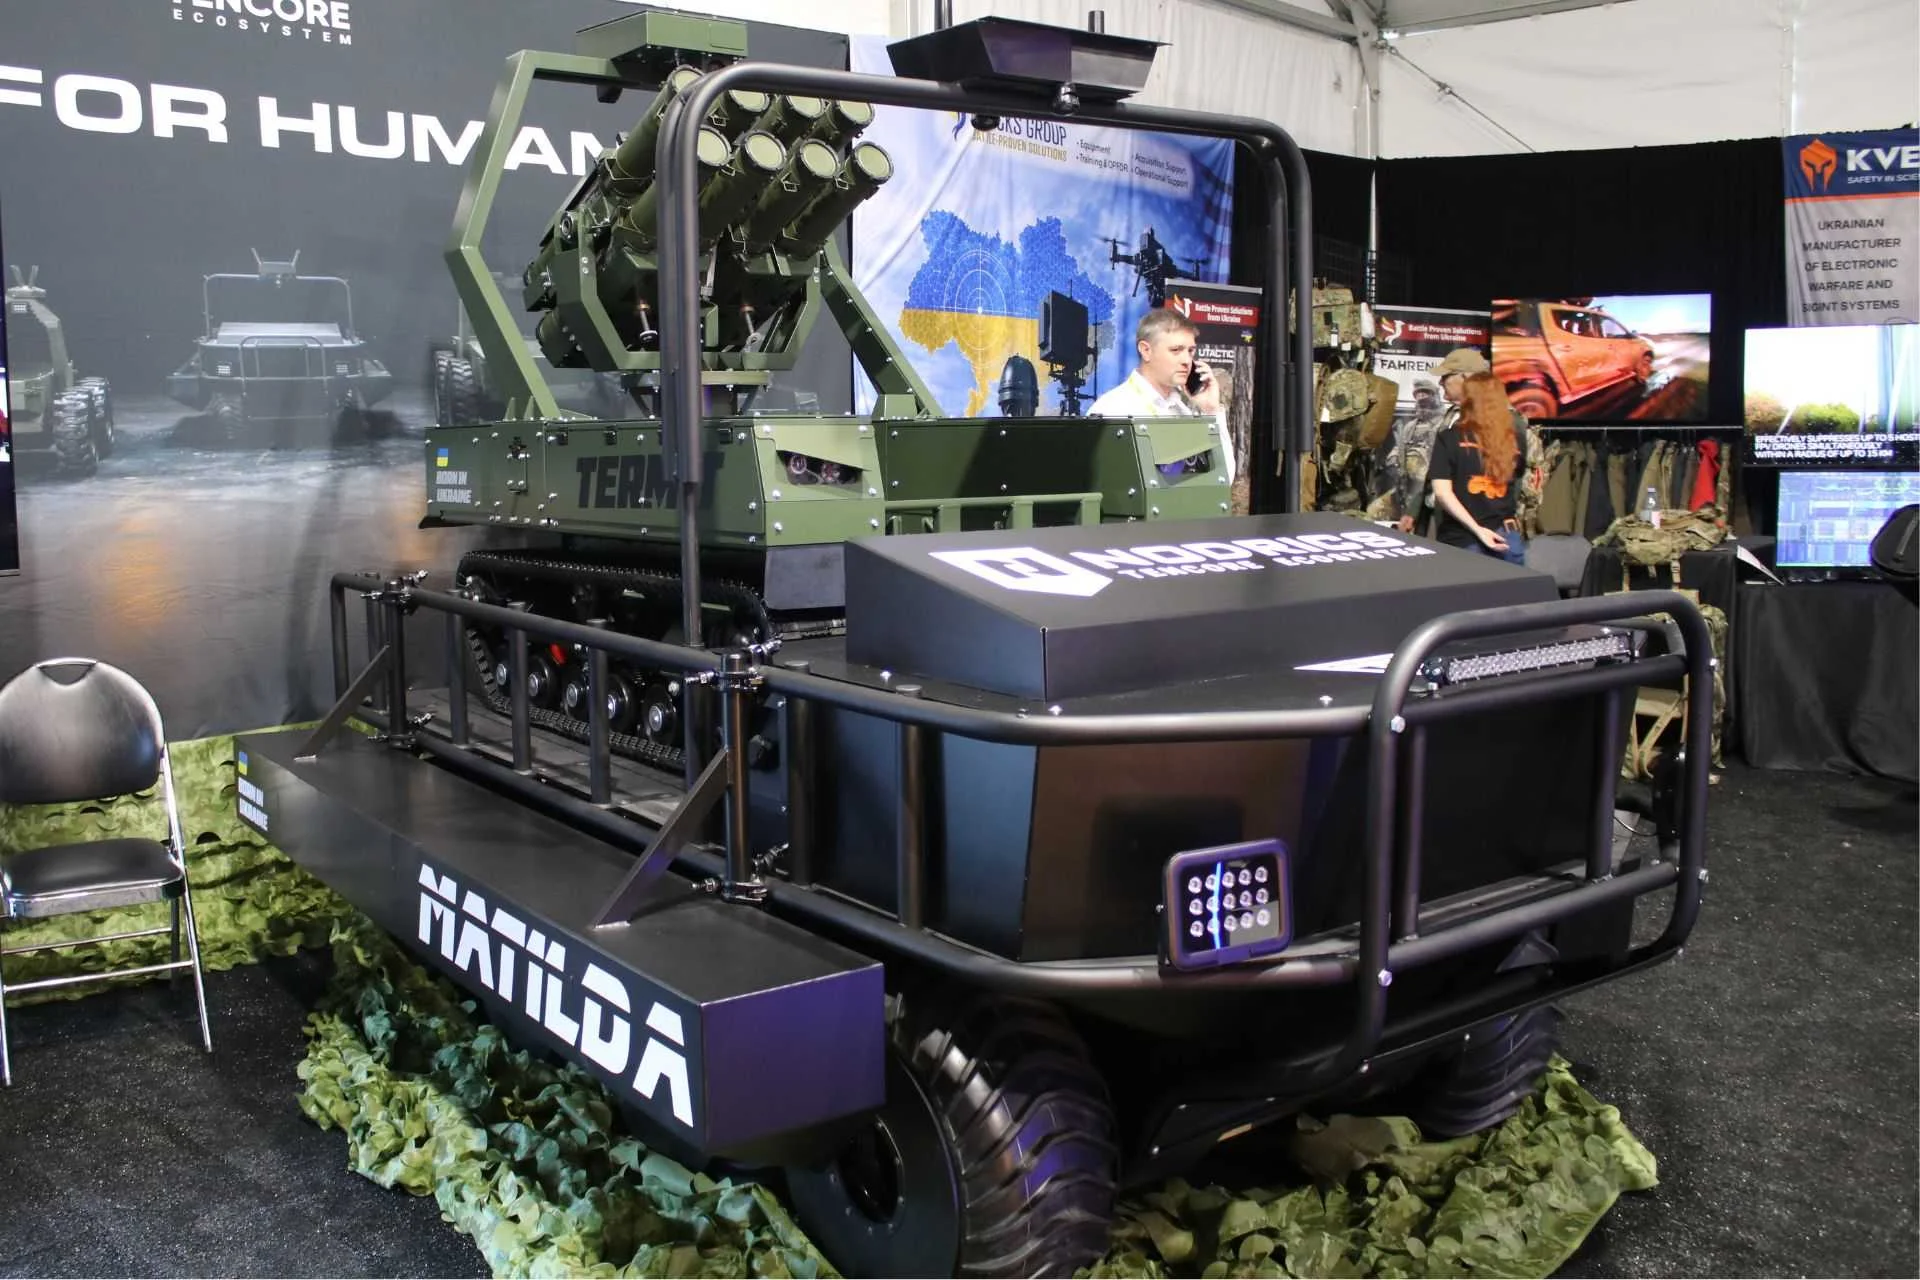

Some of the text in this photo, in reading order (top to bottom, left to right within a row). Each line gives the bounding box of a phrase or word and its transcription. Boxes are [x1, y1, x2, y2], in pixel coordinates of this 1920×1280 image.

[172, 0, 351, 30] CORE
[173, 9, 352, 45] ECOSYSTEM
[1026, 119, 1067, 147] GROUP
[1080, 139, 1111, 154] Equipment
[1080, 153, 1103, 169] Training
[1166, 161, 1188, 175] Support
[1134, 166, 1189, 189] Operational Support
[1847, 175, 1883, 184] SAFETY
[1817, 218, 1885, 231] UKRAINIAN
[1802, 238, 1902, 252] MANUFACTURER
[1804, 258, 1899, 272] OF ELECTRONIC
[1808, 279, 1894, 293] WARFARE AND
[1802, 299, 1901, 313] SIGINT SYSTEMS
[1408, 324, 1482, 336] Battle Proven Solutions
[1441, 333, 1467, 342] Ukraine
[1380, 359, 1438, 372] FAHREN
[1754, 434, 1807, 443] EFFECTIVELY
[1807, 434, 1860, 443] SUPPRESSES
[1861, 434, 1874, 442] UP
[1772, 442, 1806, 450] DRONES
[1807, 441, 1883, 450] SIMULTANEOUSLY
[1754, 450, 1785, 459] WITHIN
[1794, 450, 1826, 458] RADIUS
[1826, 450, 1840, 458] OF
[576, 451, 725, 509] TERMT
[1069, 530, 1407, 569] NODRICS
[1117, 545, 1437, 580] TENCORE ECOSYSTEM
[418, 863, 694, 1129] MATILDA
